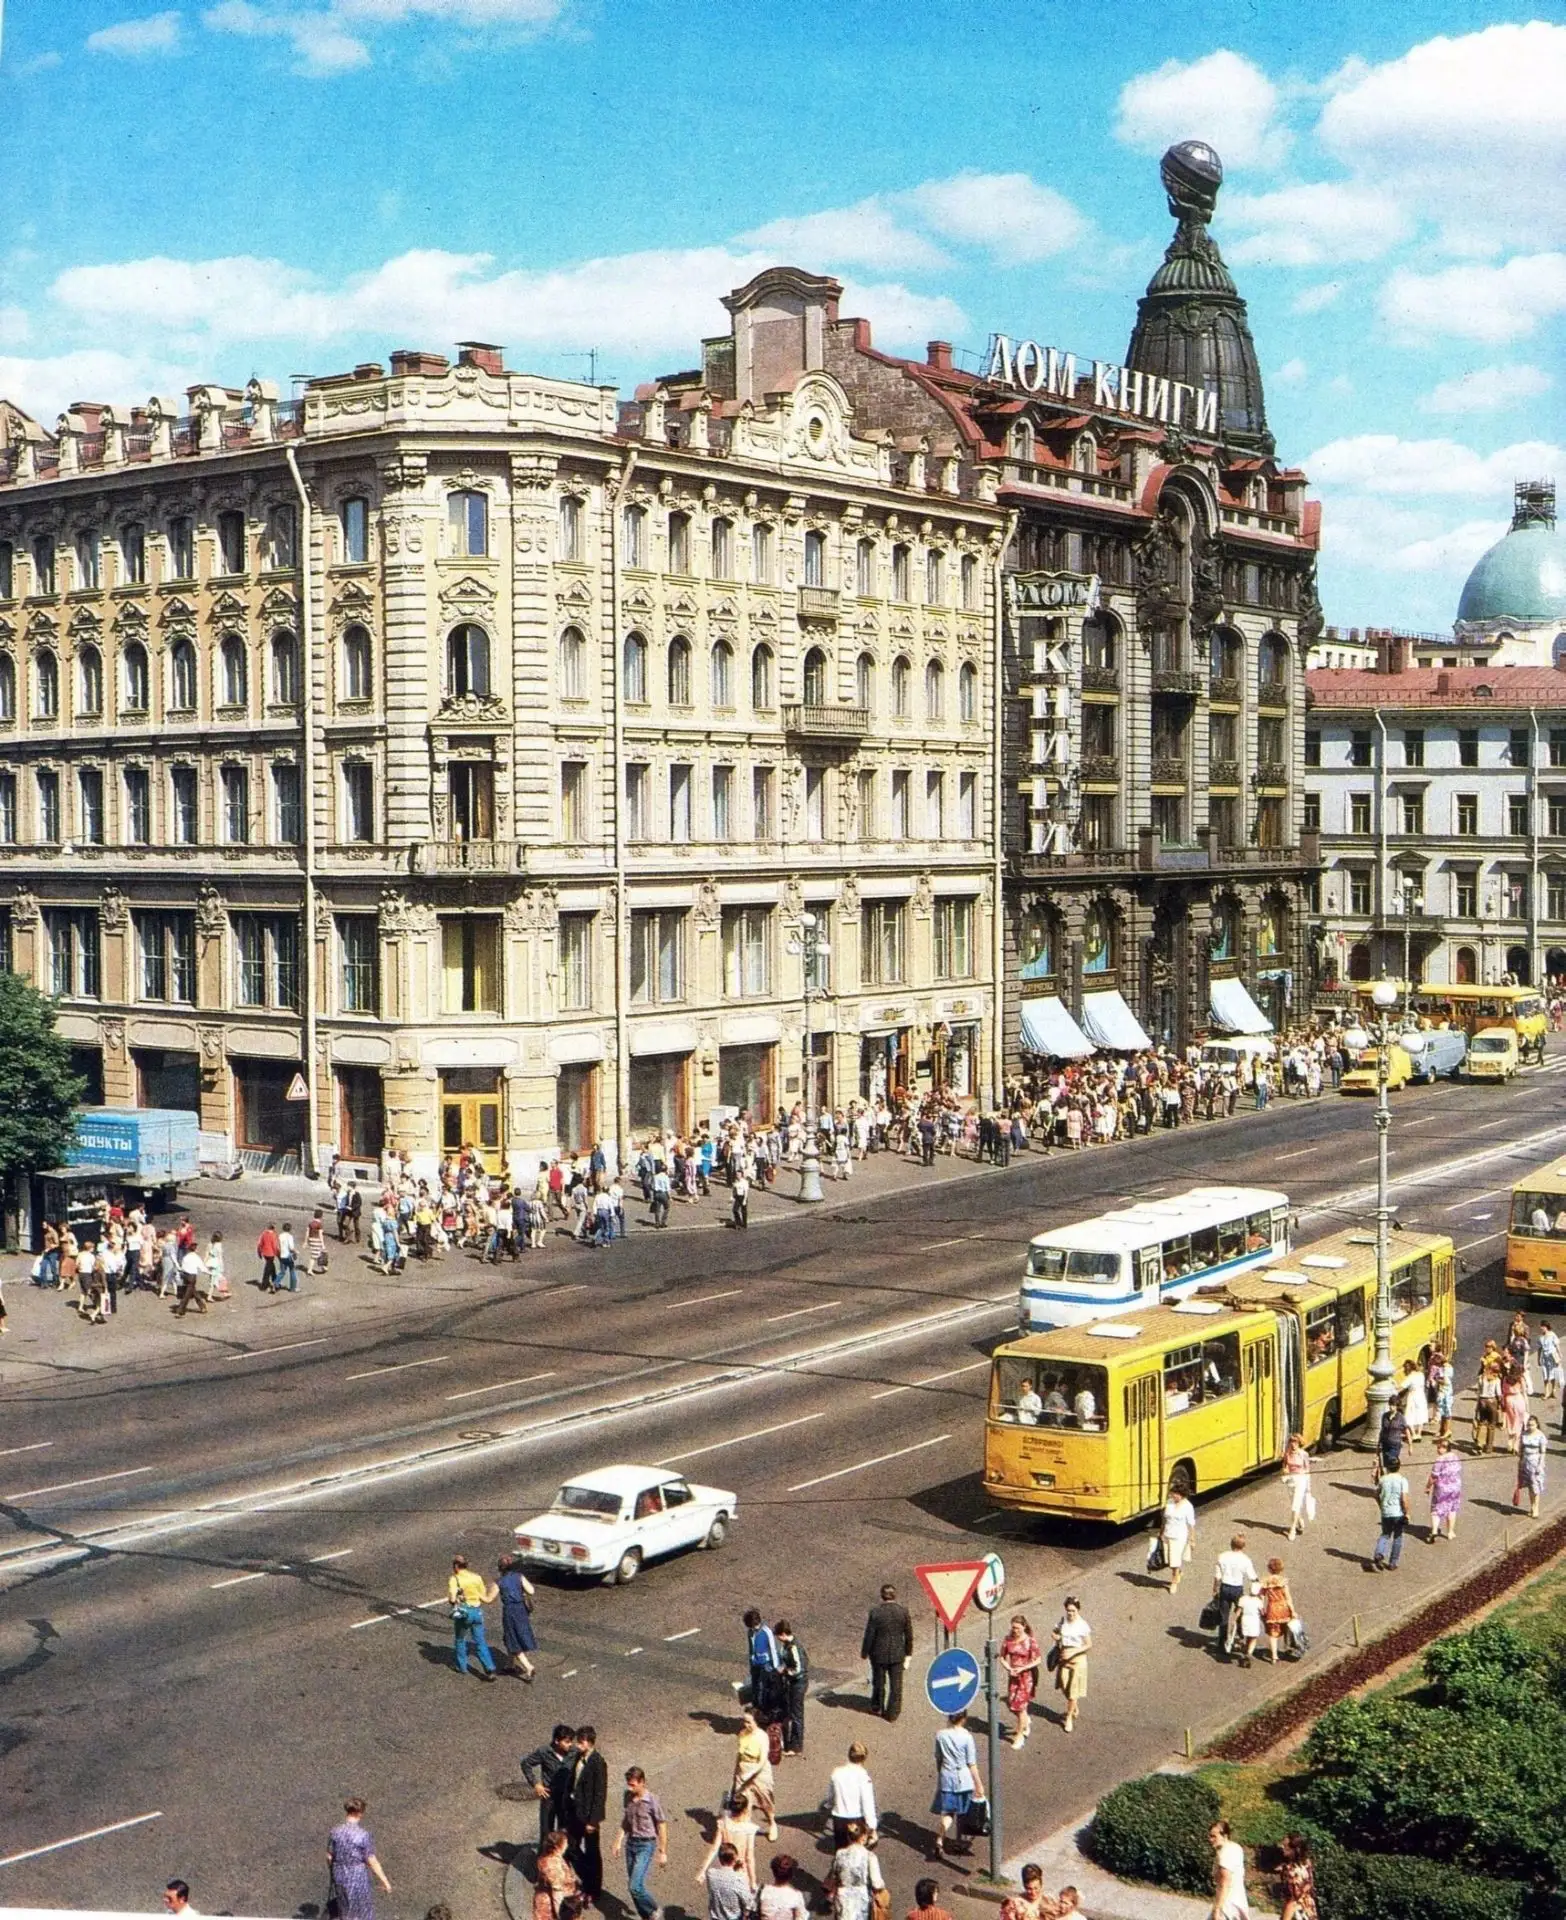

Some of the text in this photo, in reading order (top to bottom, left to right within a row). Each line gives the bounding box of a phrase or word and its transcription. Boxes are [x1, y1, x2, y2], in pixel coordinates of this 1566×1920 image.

[987, 333, 1219, 434] ДОМ КНИГИ
[1017, 582, 1089, 606] ДОМ
[1029, 639, 1074, 855] КНИГИ
[64, 1132, 132, 1152] ОДУКТЫ
